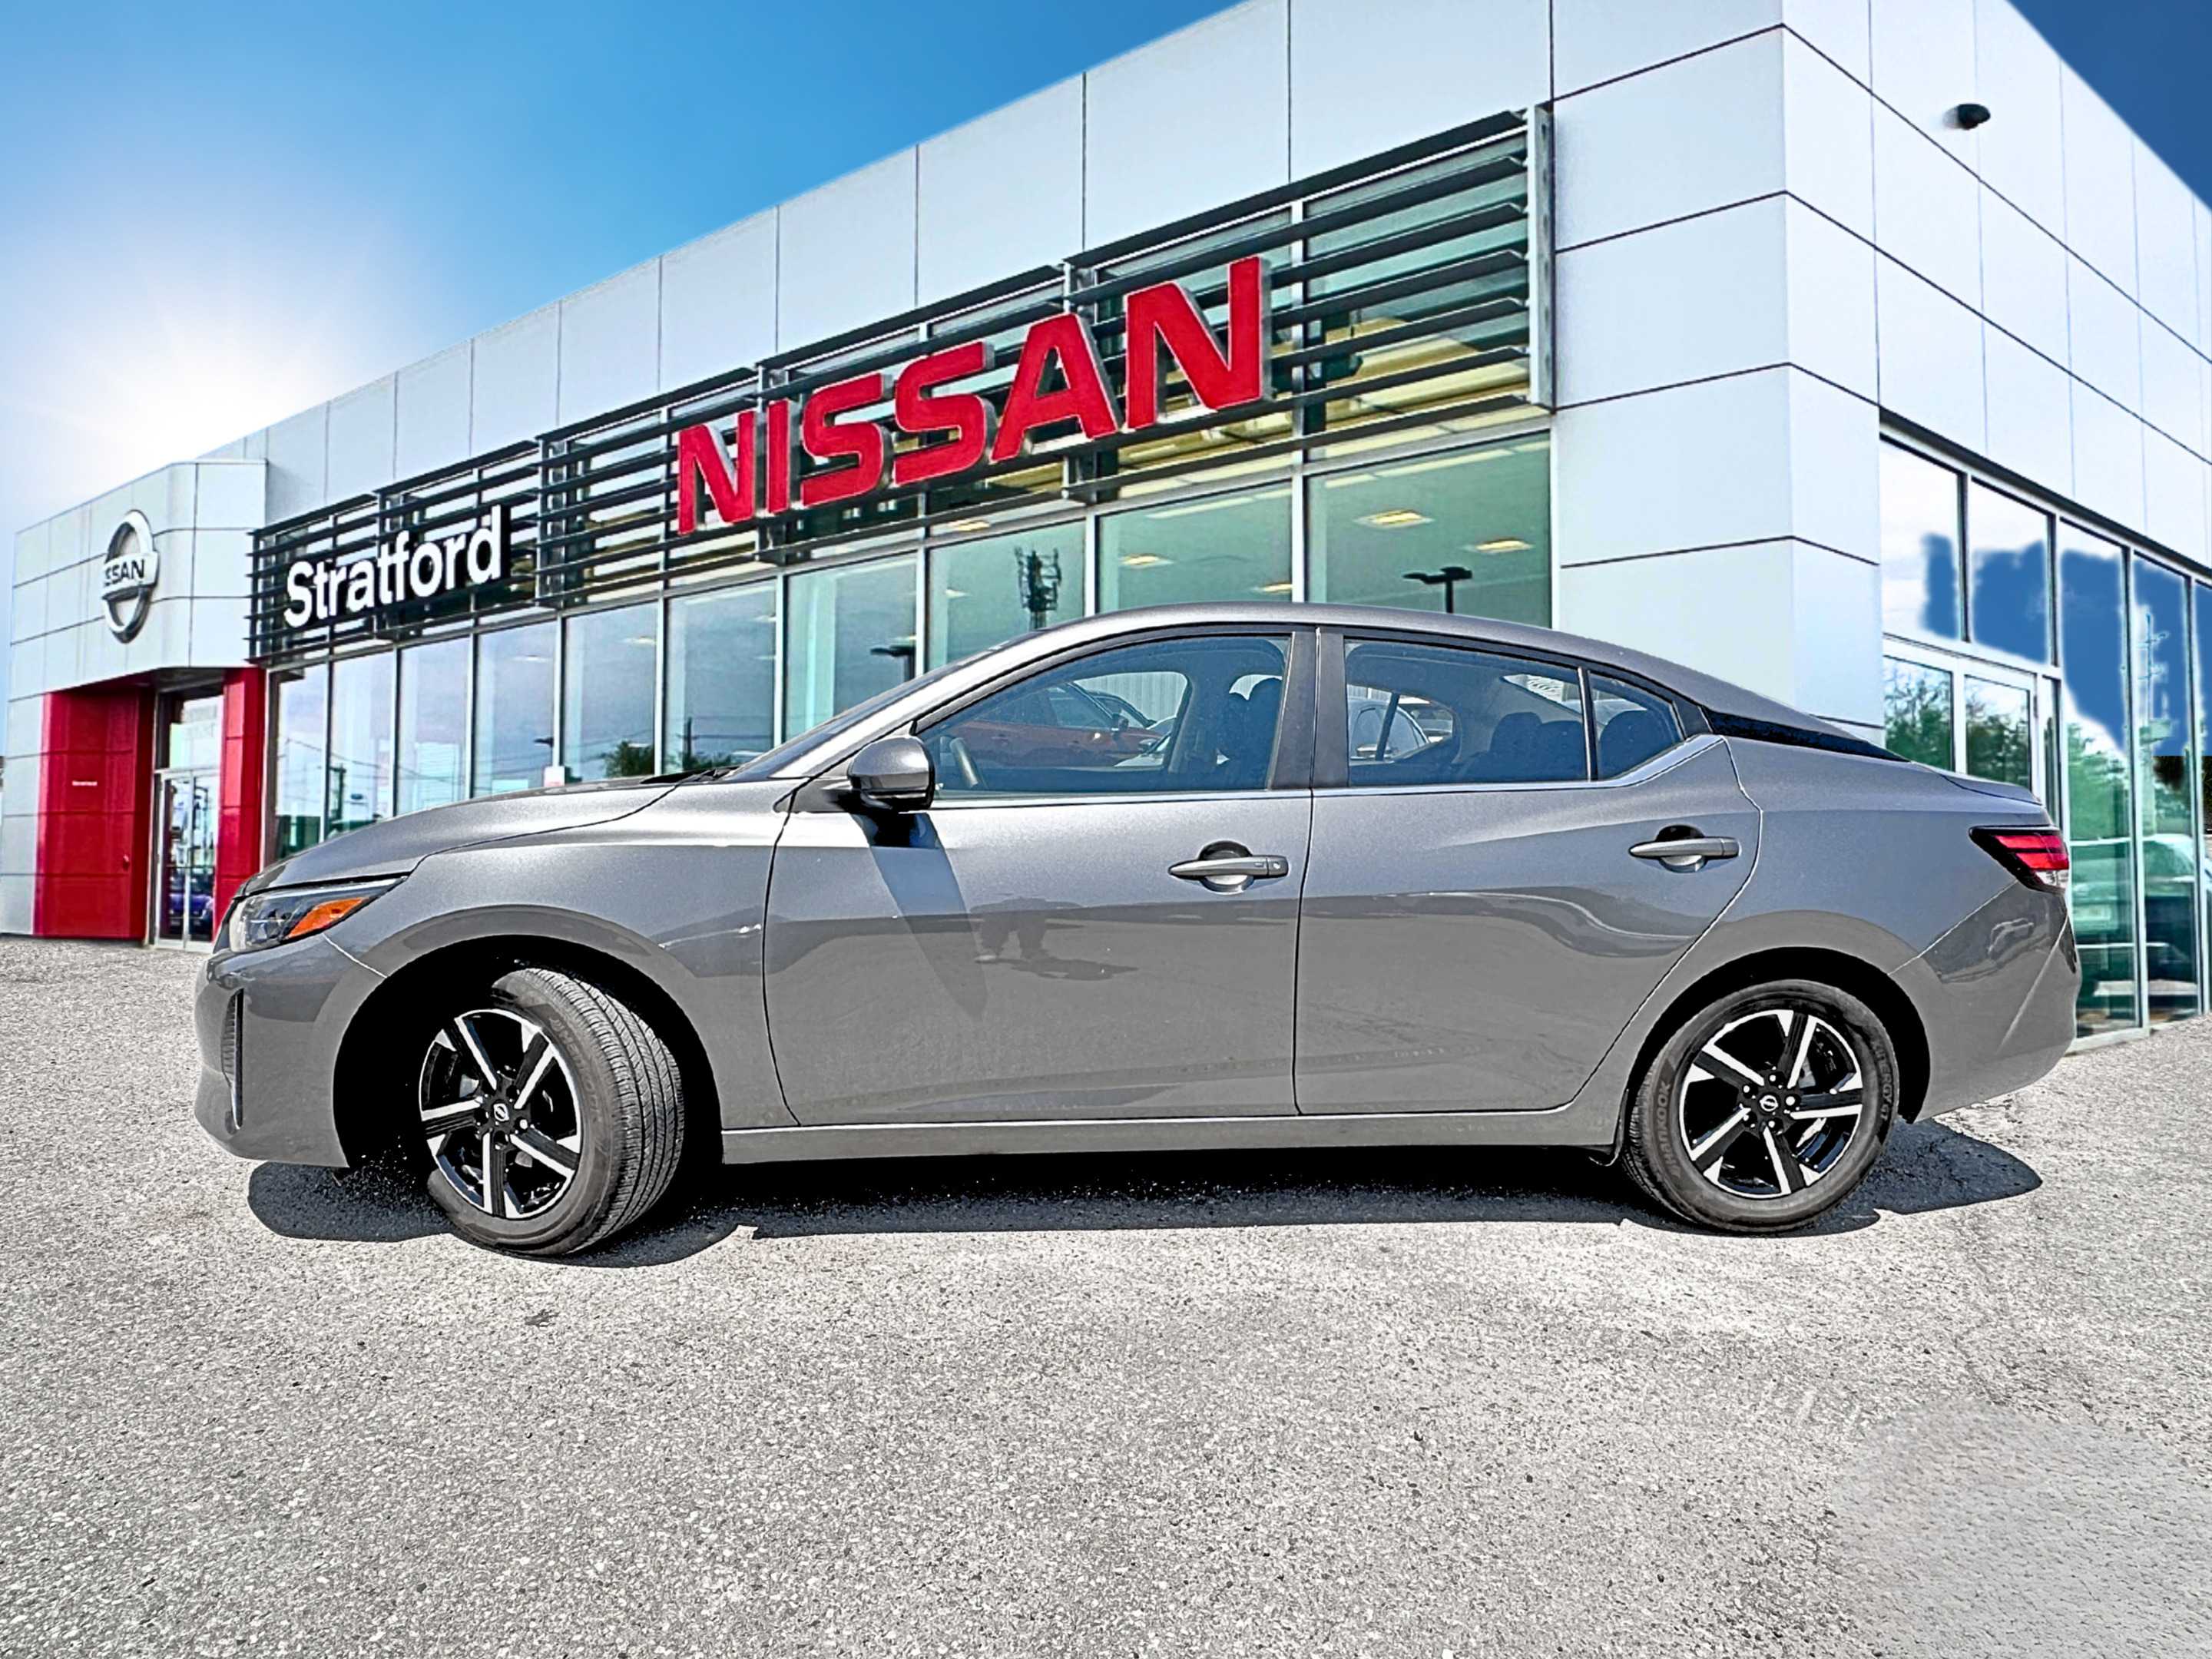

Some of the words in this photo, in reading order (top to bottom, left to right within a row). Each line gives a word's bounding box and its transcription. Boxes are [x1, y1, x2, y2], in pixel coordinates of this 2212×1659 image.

[677, 256, 1262, 535] NISSAN
[104, 558, 145, 586] SSAN
[284, 504, 502, 628] Stratford
